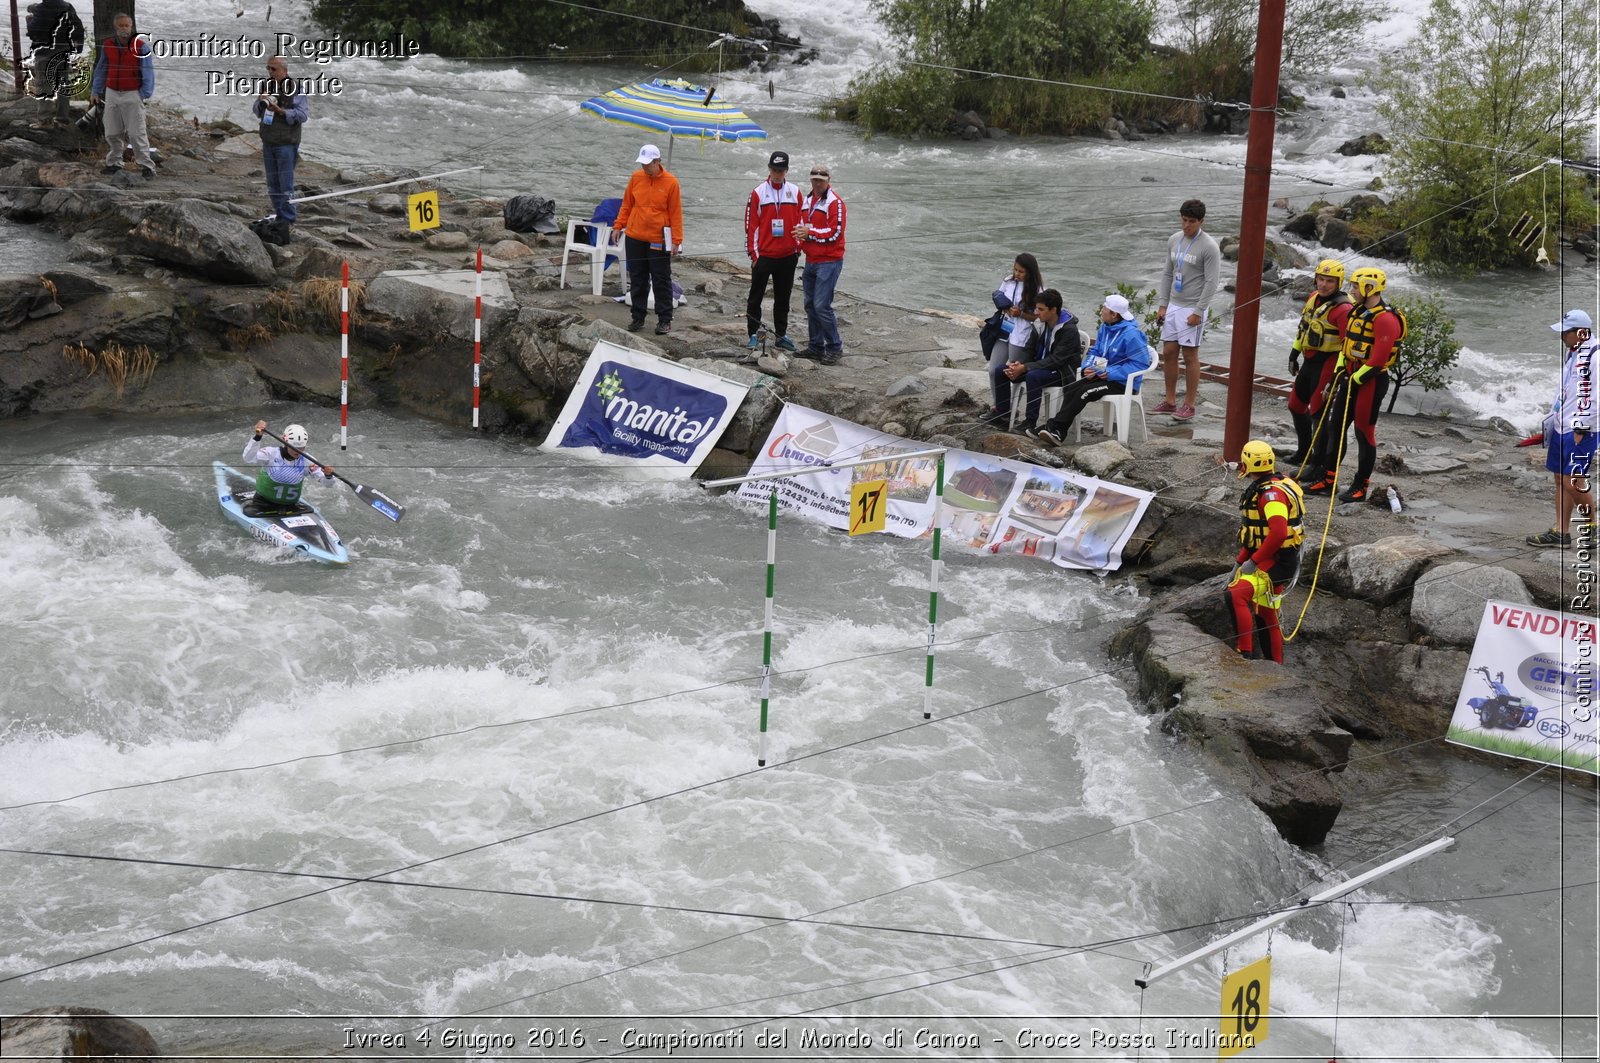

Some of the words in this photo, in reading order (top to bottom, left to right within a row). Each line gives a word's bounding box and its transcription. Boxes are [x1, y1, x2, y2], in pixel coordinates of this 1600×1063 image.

[415, 199, 434, 223] 16
[604, 396, 714, 444] manital
[613, 427, 641, 446] facility
[642, 439, 688, 456] manaent
[274, 485, 299, 500] 15
[858, 490, 880, 523] 17
[830, 496, 851, 507] Borgo
[884, 512, 900, 521] vrea
[900, 517, 918, 528] (TO)
[1492, 605, 1598, 645] VENDITA
[1533, 657, 1568, 668] MACCHINE
[1534, 684, 1579, 697] GIARDINAGG
[1540, 721, 1567, 735] BCS
[1231, 979, 1261, 1036] 18
